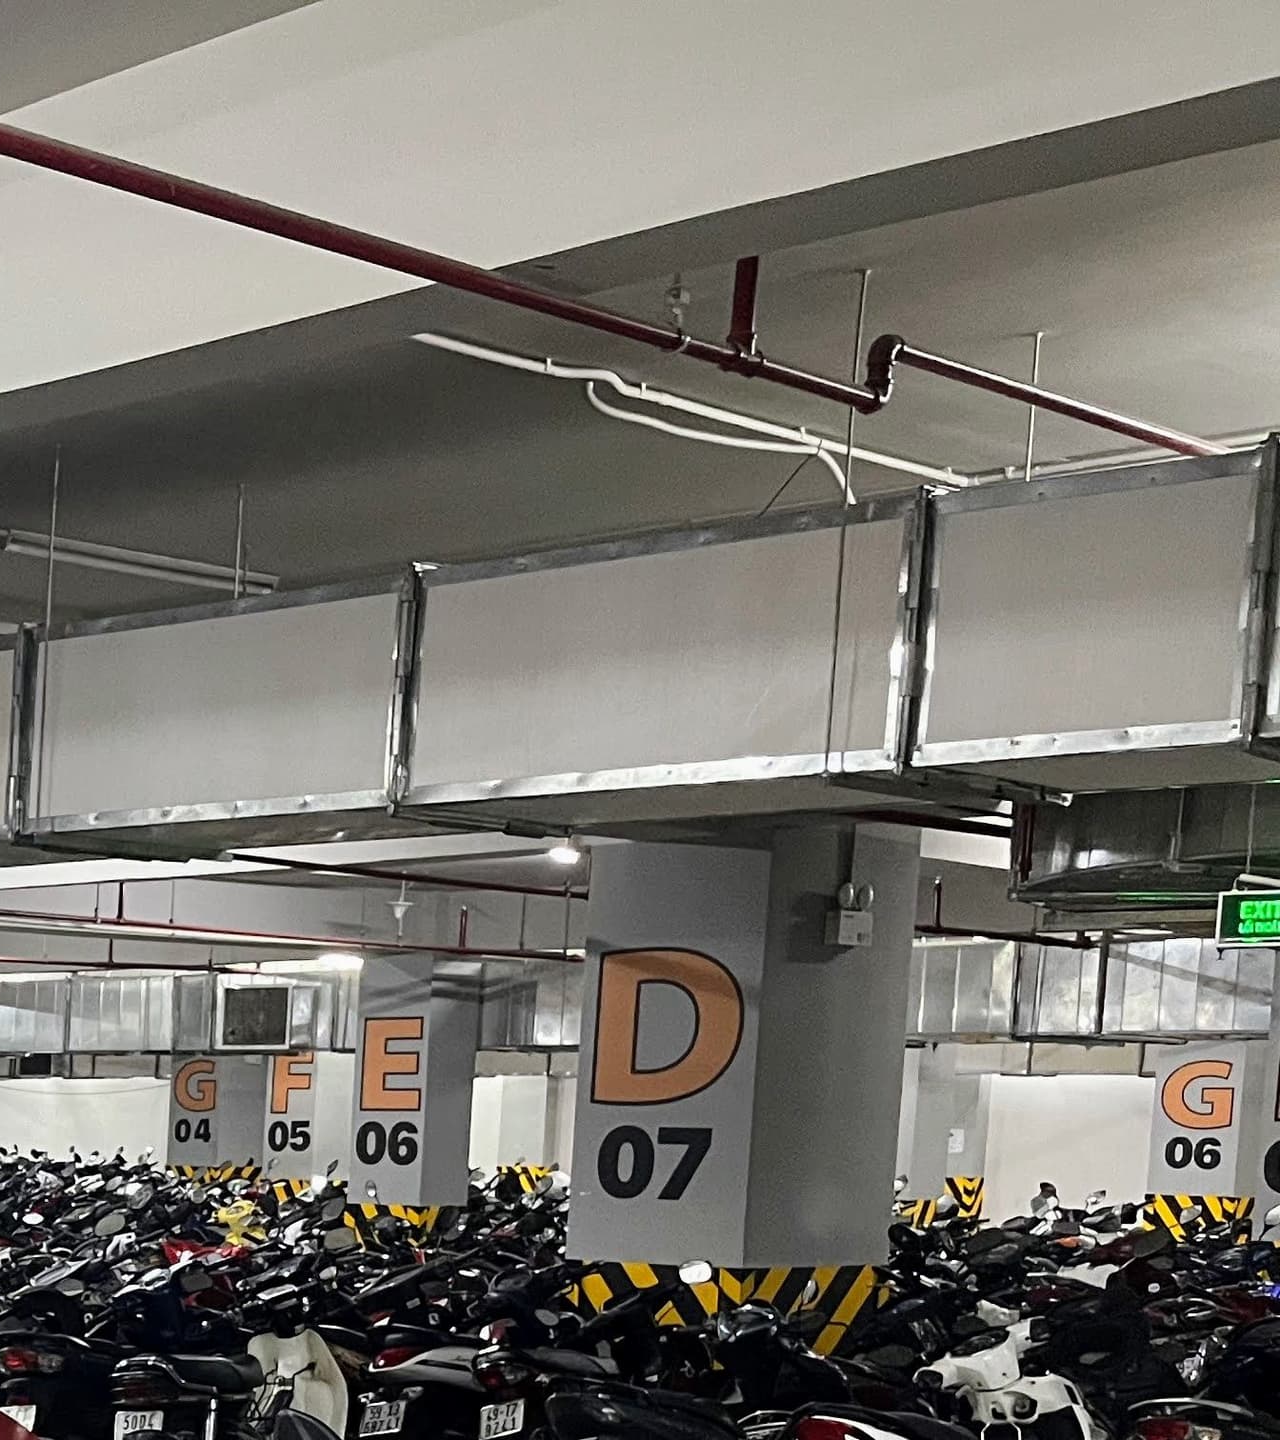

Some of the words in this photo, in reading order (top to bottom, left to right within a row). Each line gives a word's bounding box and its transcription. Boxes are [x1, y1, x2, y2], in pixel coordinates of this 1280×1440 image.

[590, 946, 745, 1106] D
[174, 1059, 217, 1112] G
[270, 1051, 314, 1114] F
[359, 1016, 424, 1112] E
[1161, 1060, 1234, 1130] G
[174, 1118, 212, 1144] 04
[268, 1120, 312, 1152] 05
[355, 1121, 419, 1166] 06
[1165, 1136, 1222, 1170] 06
[597, 1125, 714, 1200] 07
